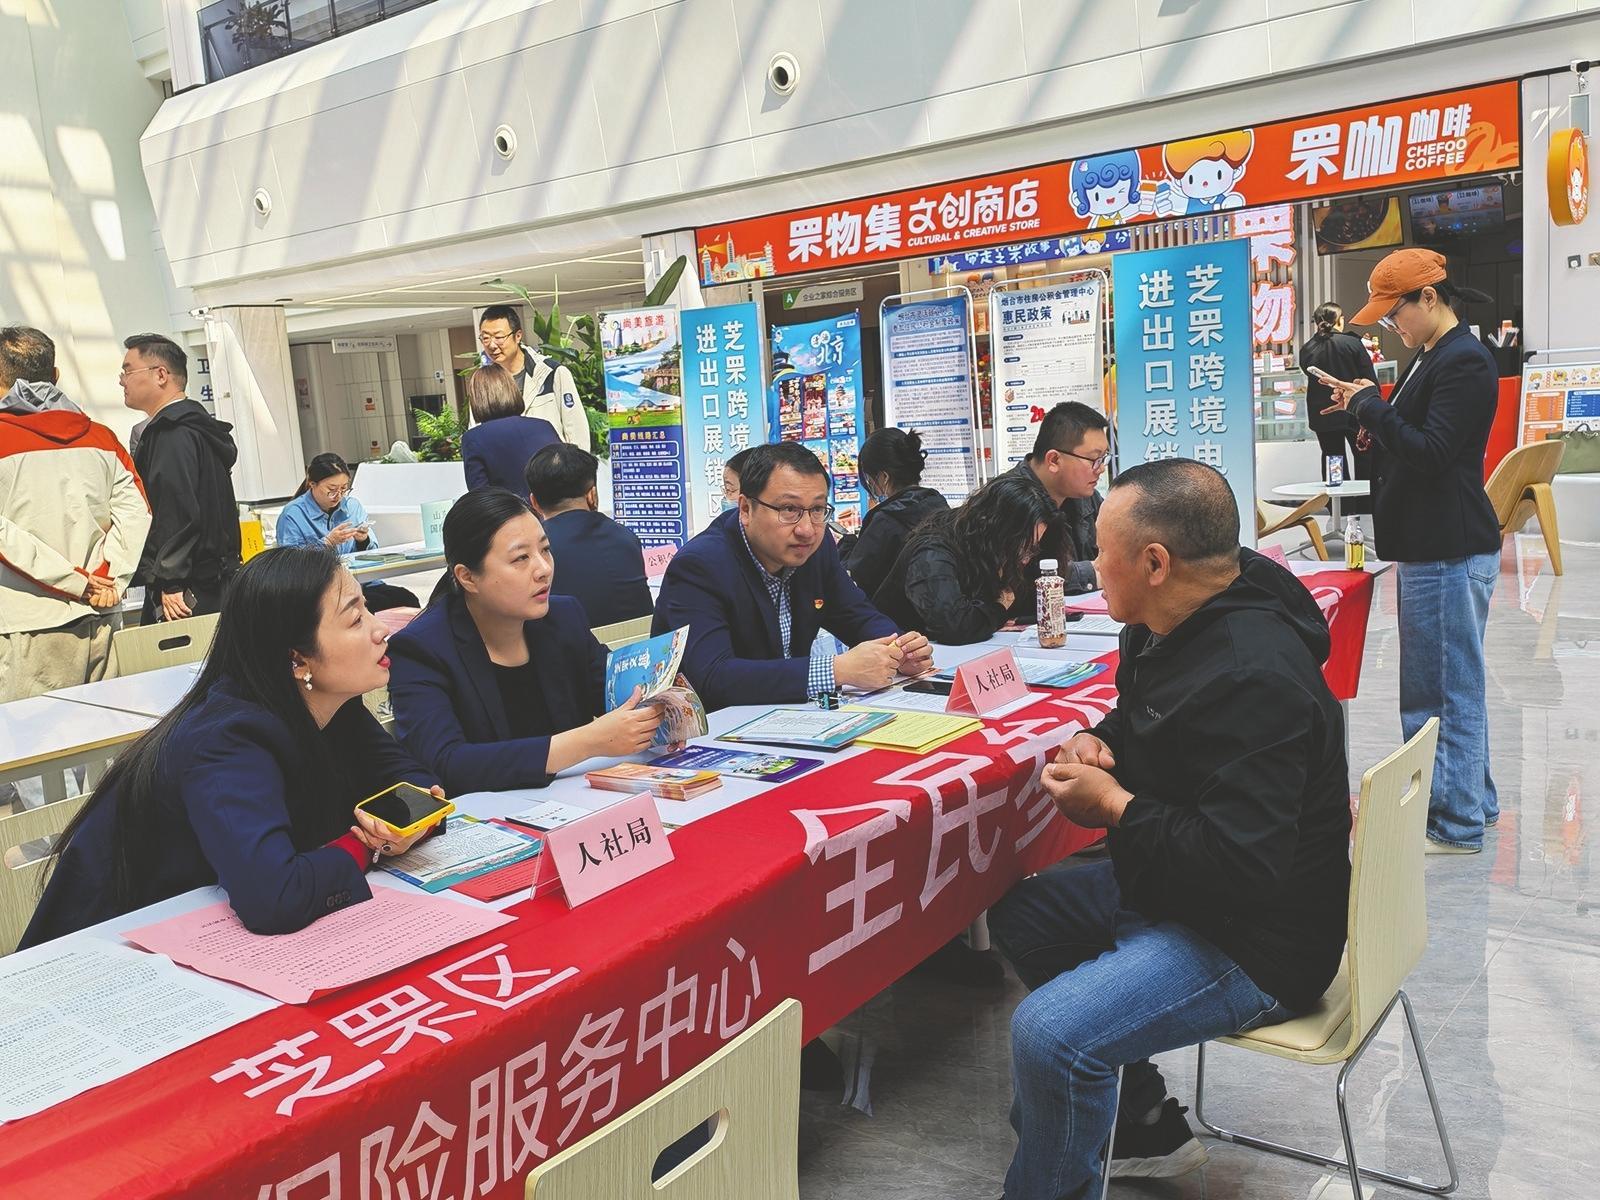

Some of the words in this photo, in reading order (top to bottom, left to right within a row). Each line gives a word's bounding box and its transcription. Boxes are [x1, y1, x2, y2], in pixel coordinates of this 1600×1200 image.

[1406, 103, 1472, 145] 咖啡
[1285, 115, 1403, 186] 罘咖
[1405, 151, 1465, 172] COFFEE
[1406, 138, 1468, 160] CHEFOO
[908, 178, 1040, 232] 文创商店
[787, 203, 902, 263] 罘物集
[907, 233, 952, 247] CULTURAL
[953, 231, 961, 240] &
[962, 223, 1008, 239] CREATIVE
[1008, 218, 1041, 230] STORE
[786, 293, 793, 303] A
[1001, 287, 1095, 306] 烟台市住房公积金管理中心
[622, 313, 665, 329] 尚美旅游
[1002, 306, 1052, 325] 惠民政策
[816, 335, 844, 365] 北京
[197, 358, 215, 417] 卫生
[974, 663, 1016, 696] 人社局
[577, 816, 652, 875] 人社局
[210, 943, 580, 1117] 芝罘区
